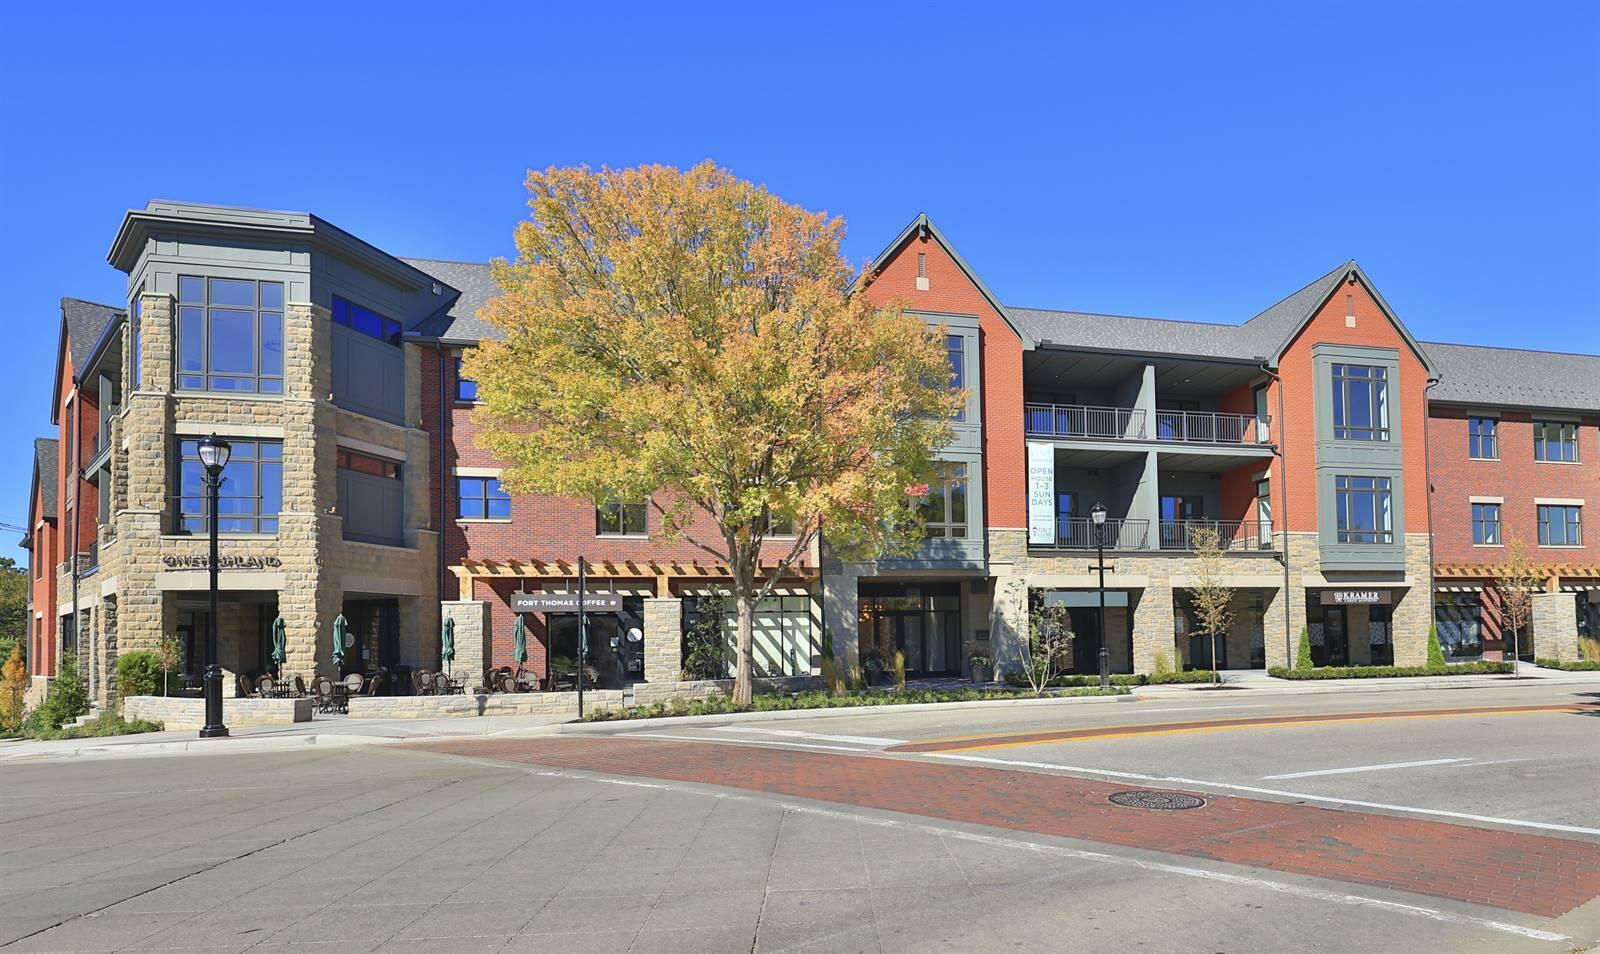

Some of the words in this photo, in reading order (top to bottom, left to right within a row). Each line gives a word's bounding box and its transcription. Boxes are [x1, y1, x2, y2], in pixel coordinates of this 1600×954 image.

[1030, 467, 1053, 475] OPEN
[1033, 490, 1051, 498] SUN
[1031, 498, 1053, 506] DAYS
[1343, 591, 1379, 599] KRAMER
